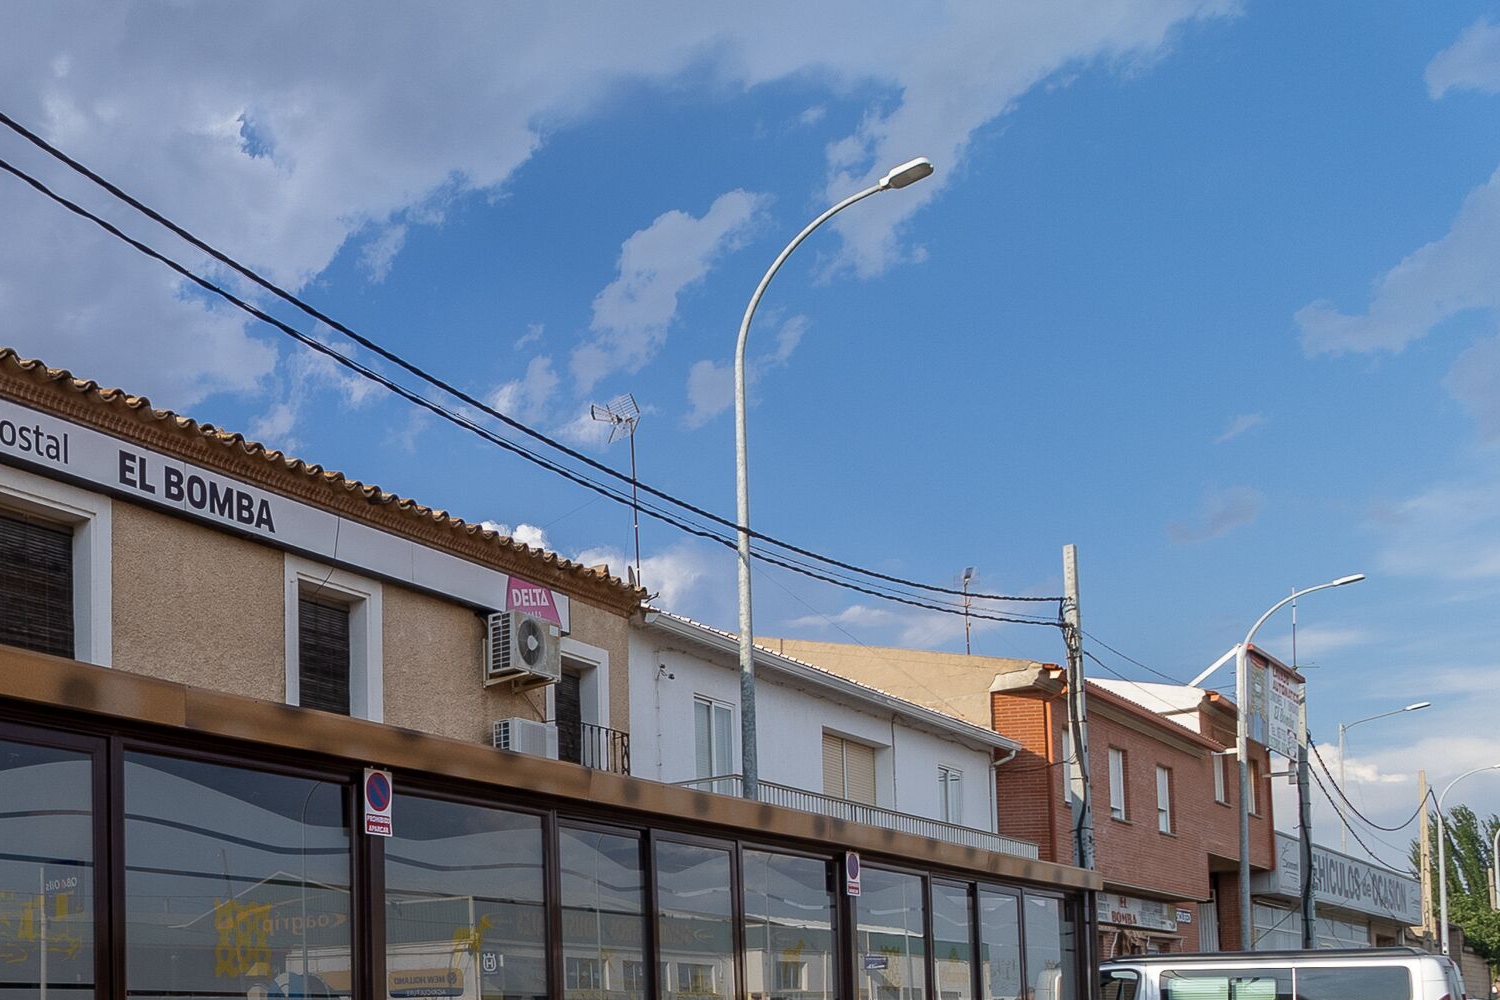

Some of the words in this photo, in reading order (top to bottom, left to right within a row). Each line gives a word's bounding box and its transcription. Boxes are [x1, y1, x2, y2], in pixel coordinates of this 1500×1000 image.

[119, 449, 156, 495] EL
[164, 465, 276, 533] BOMBA
[512, 588, 549, 607] DELTA
[1111, 910, 1137, 924] BOMBA
